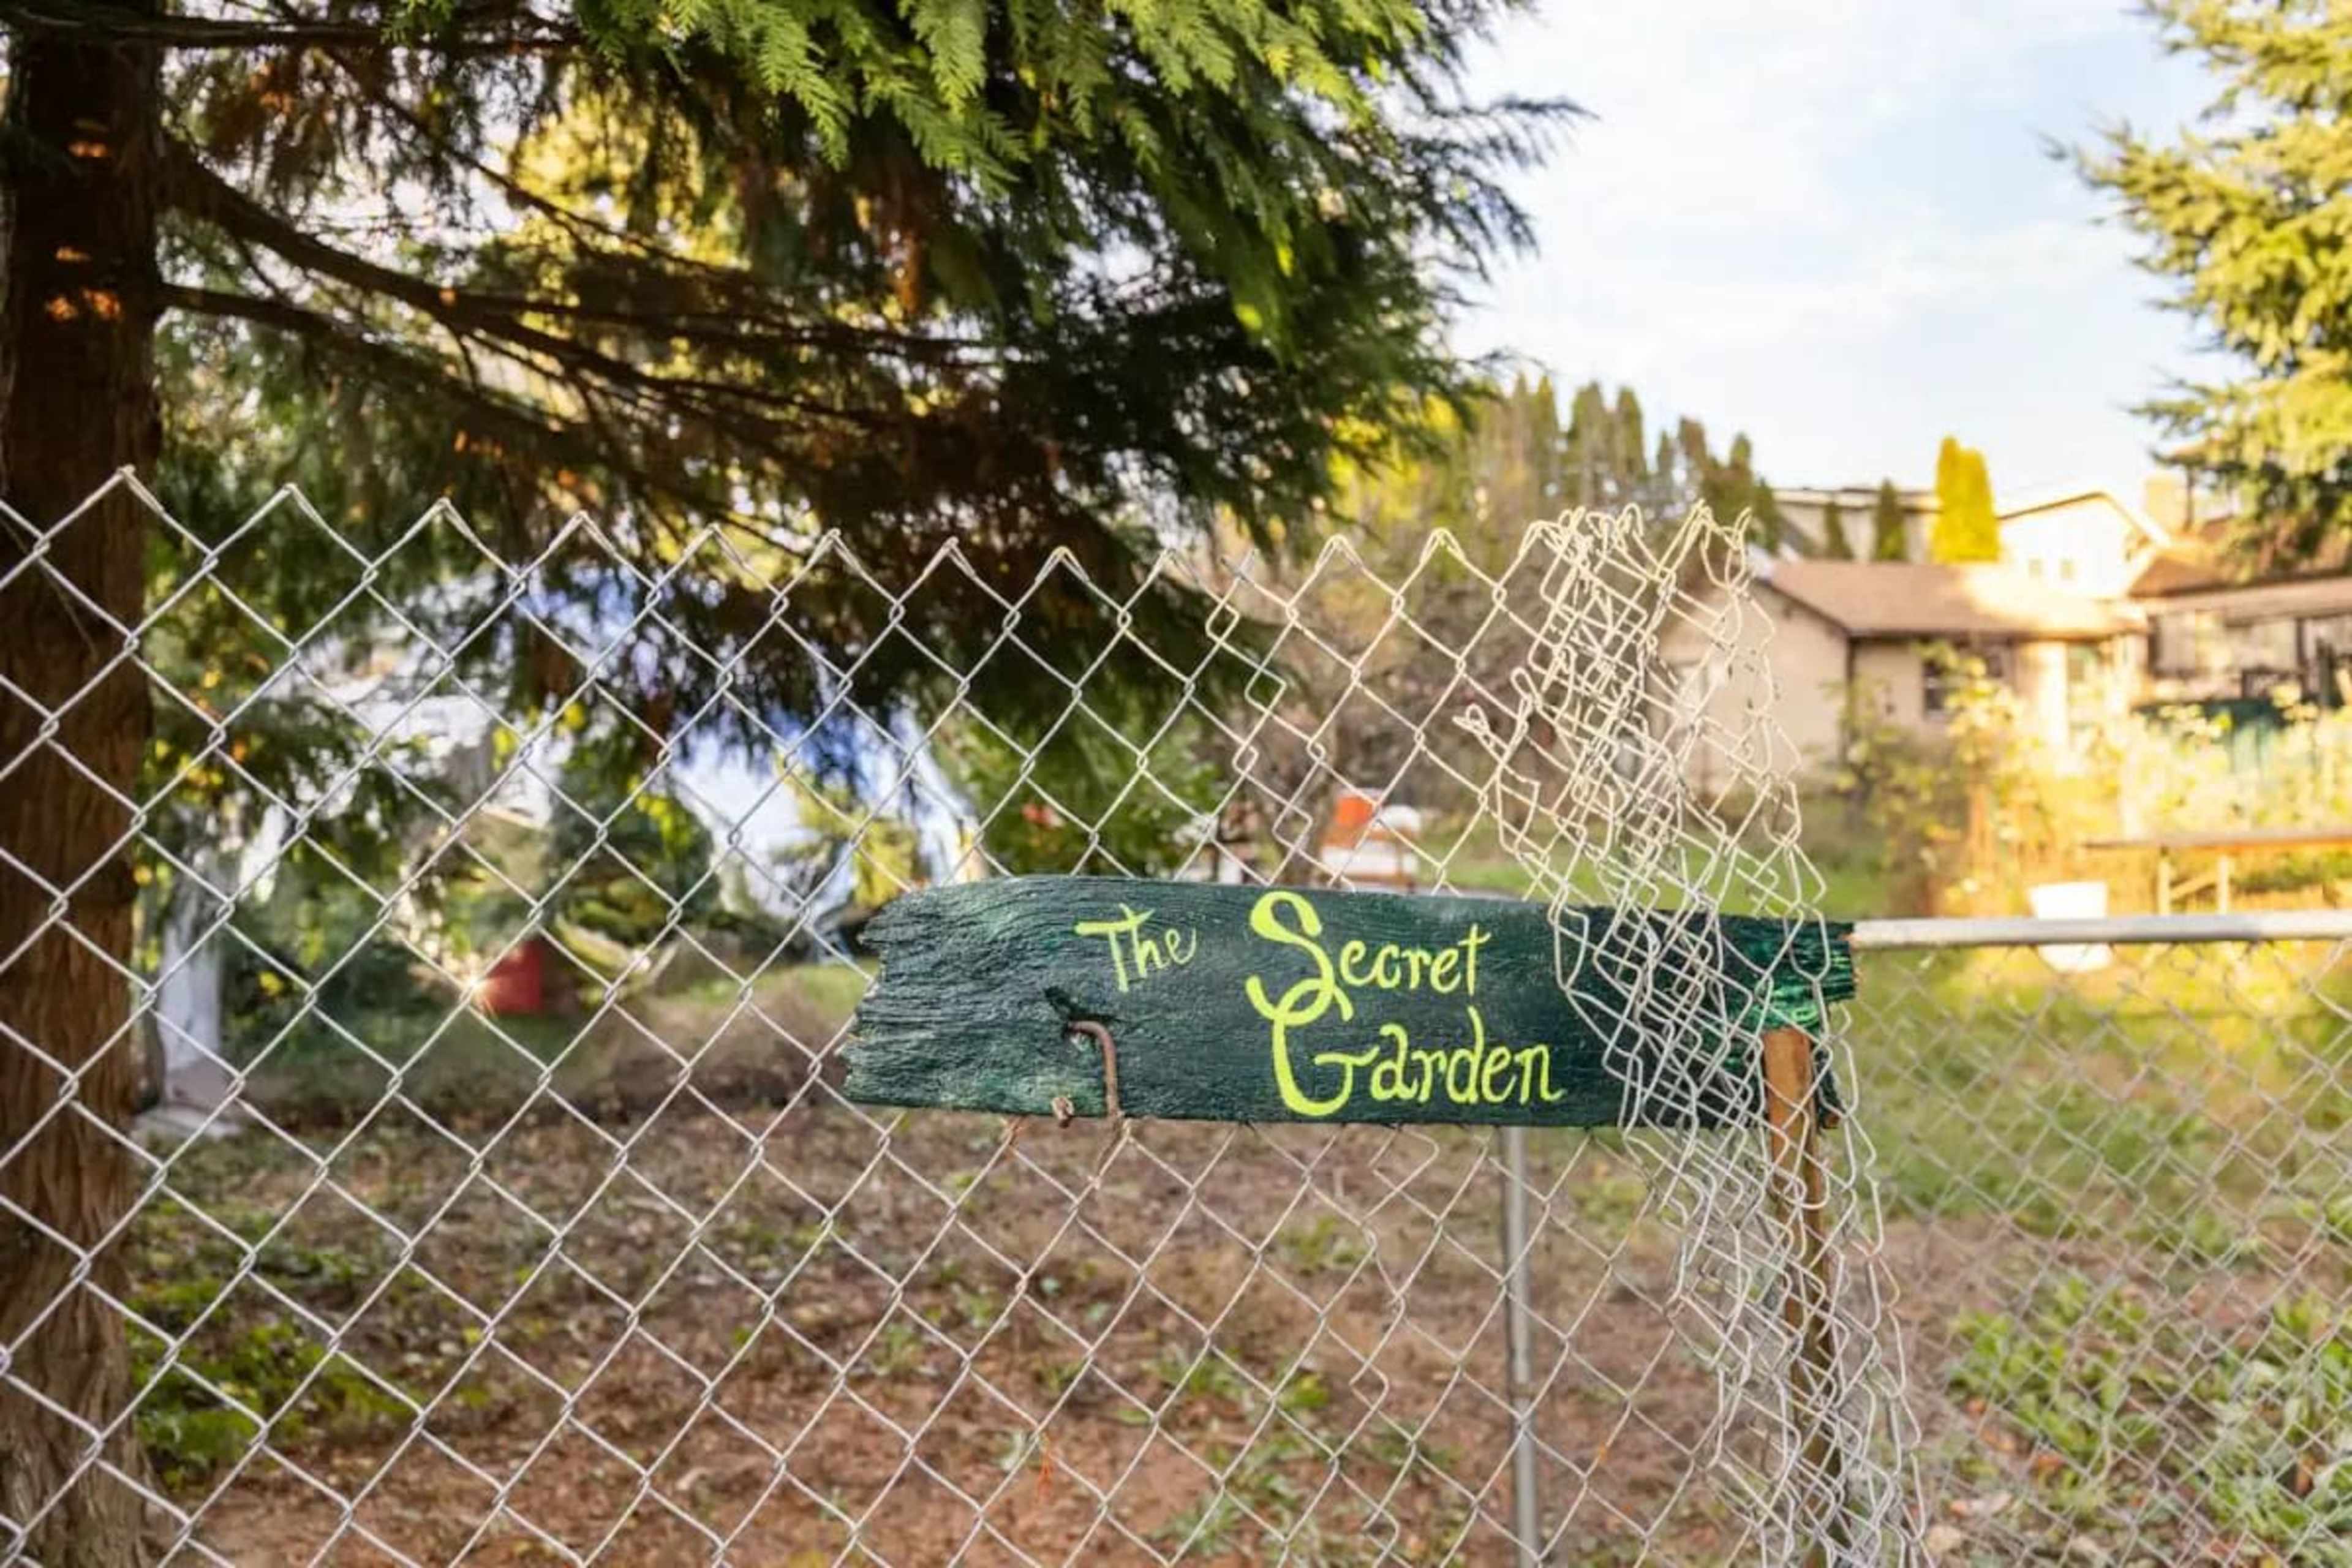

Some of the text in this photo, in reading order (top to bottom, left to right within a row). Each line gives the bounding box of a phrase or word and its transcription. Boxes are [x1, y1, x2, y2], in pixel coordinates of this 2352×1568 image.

[1074, 891, 1492, 1026] The Secret
[1271, 982, 1564, 1117] Garden
